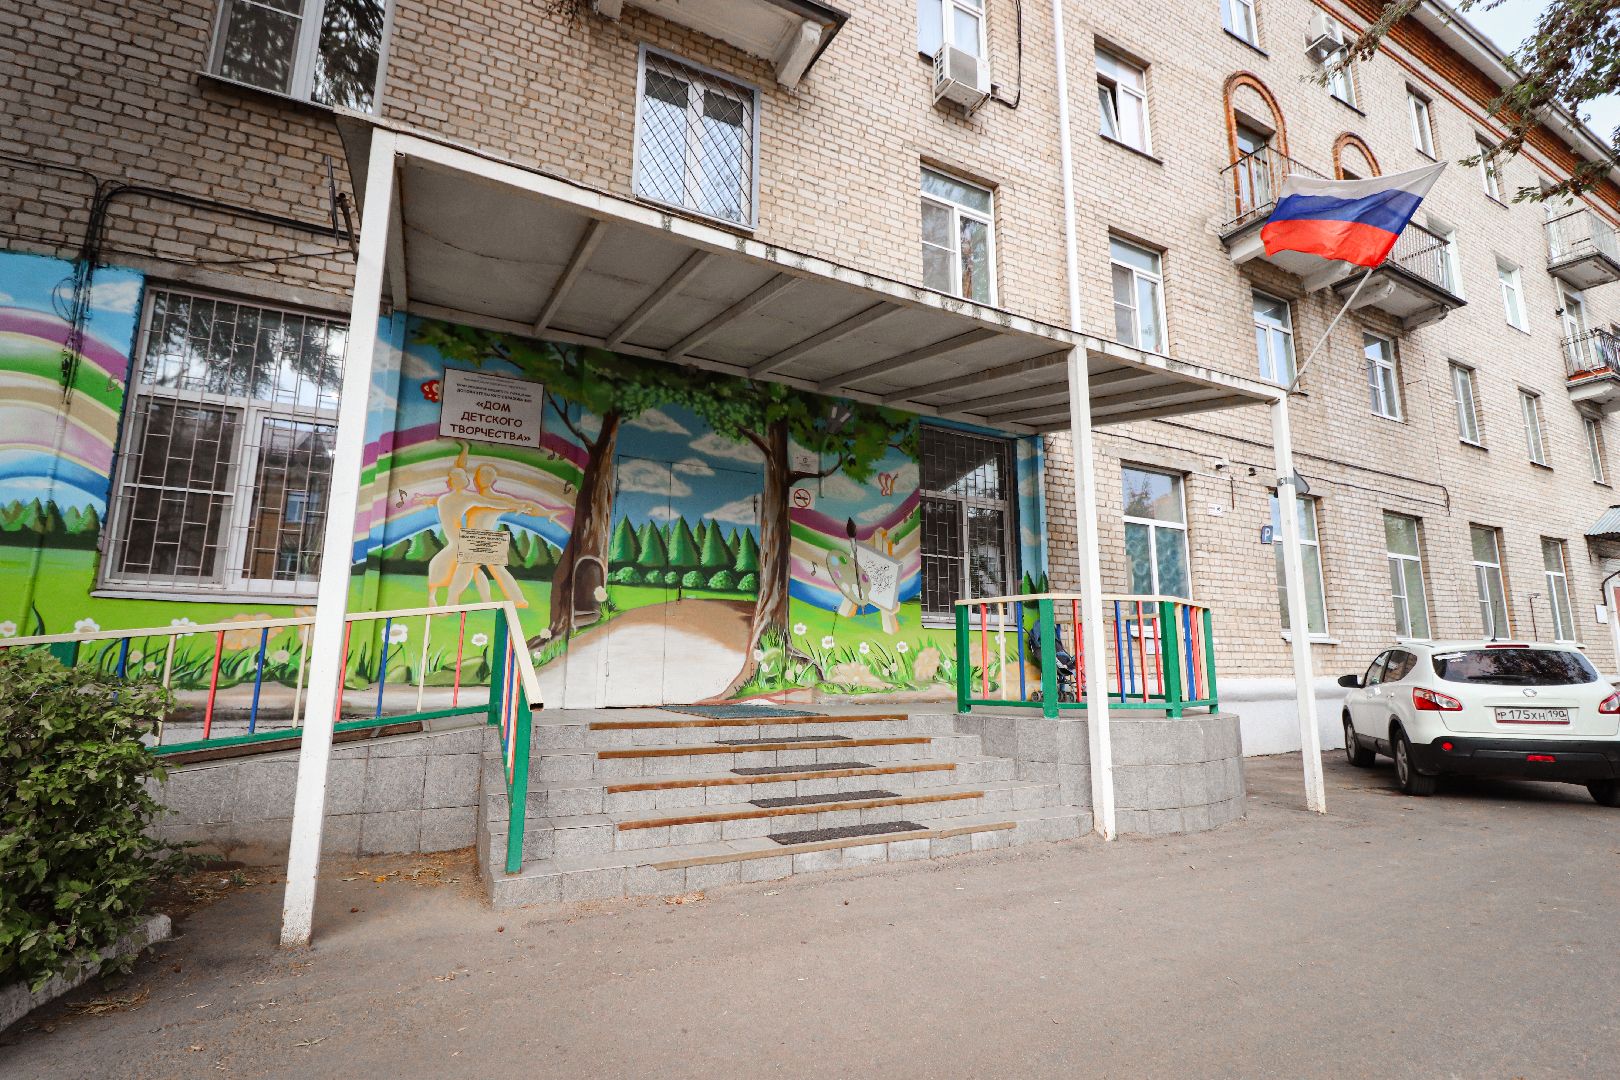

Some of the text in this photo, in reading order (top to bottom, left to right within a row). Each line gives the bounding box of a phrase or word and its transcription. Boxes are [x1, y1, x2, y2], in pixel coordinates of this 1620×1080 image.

[476, 400, 511, 412] «ДОМ
[460, 411, 523, 427] ДЕТСКОГО
[450, 423, 531, 441] ТВОРЧЕСТВА»
